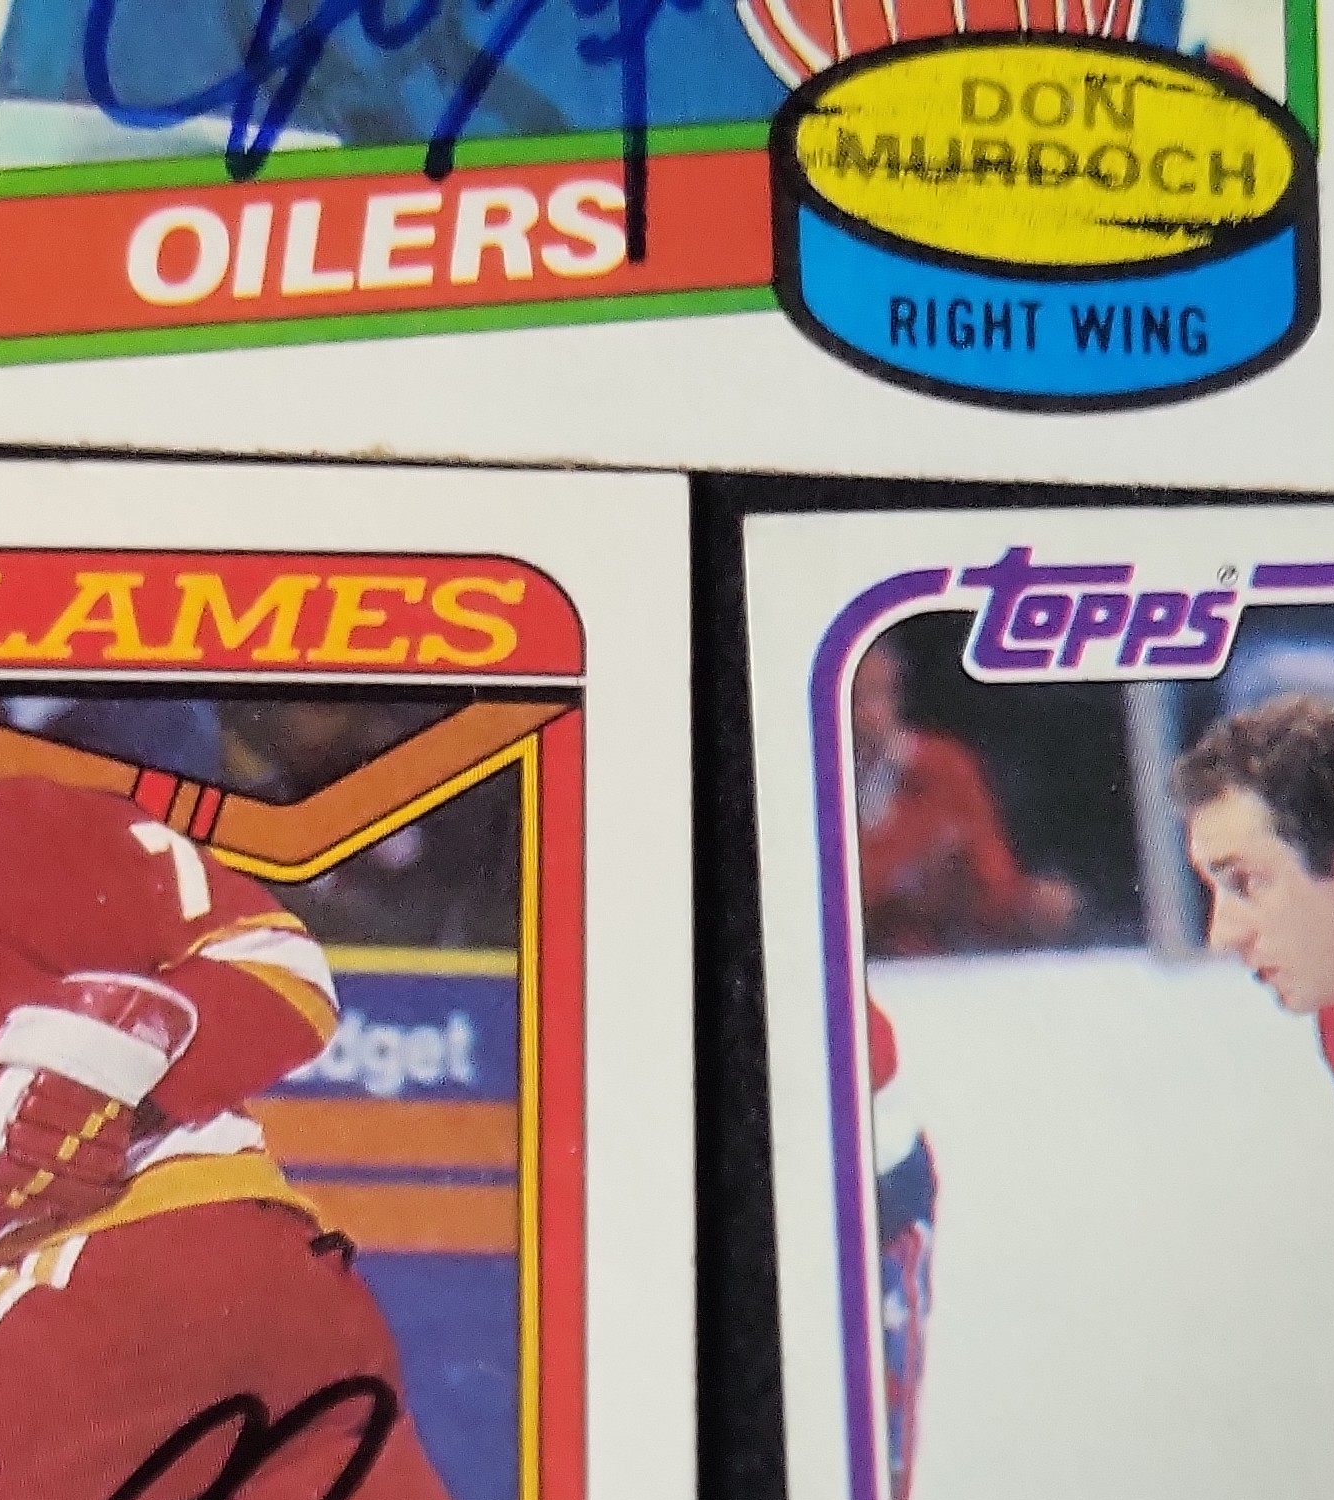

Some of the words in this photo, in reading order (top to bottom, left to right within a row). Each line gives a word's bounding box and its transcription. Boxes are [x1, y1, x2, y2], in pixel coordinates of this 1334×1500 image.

[959, 74, 1136, 131] DON
[833, 128, 1258, 200] MURDOCH
[125, 176, 629, 307] OILERS
[889, 296, 1039, 352] RIGHT
[1070, 303, 1209, 358] WING
